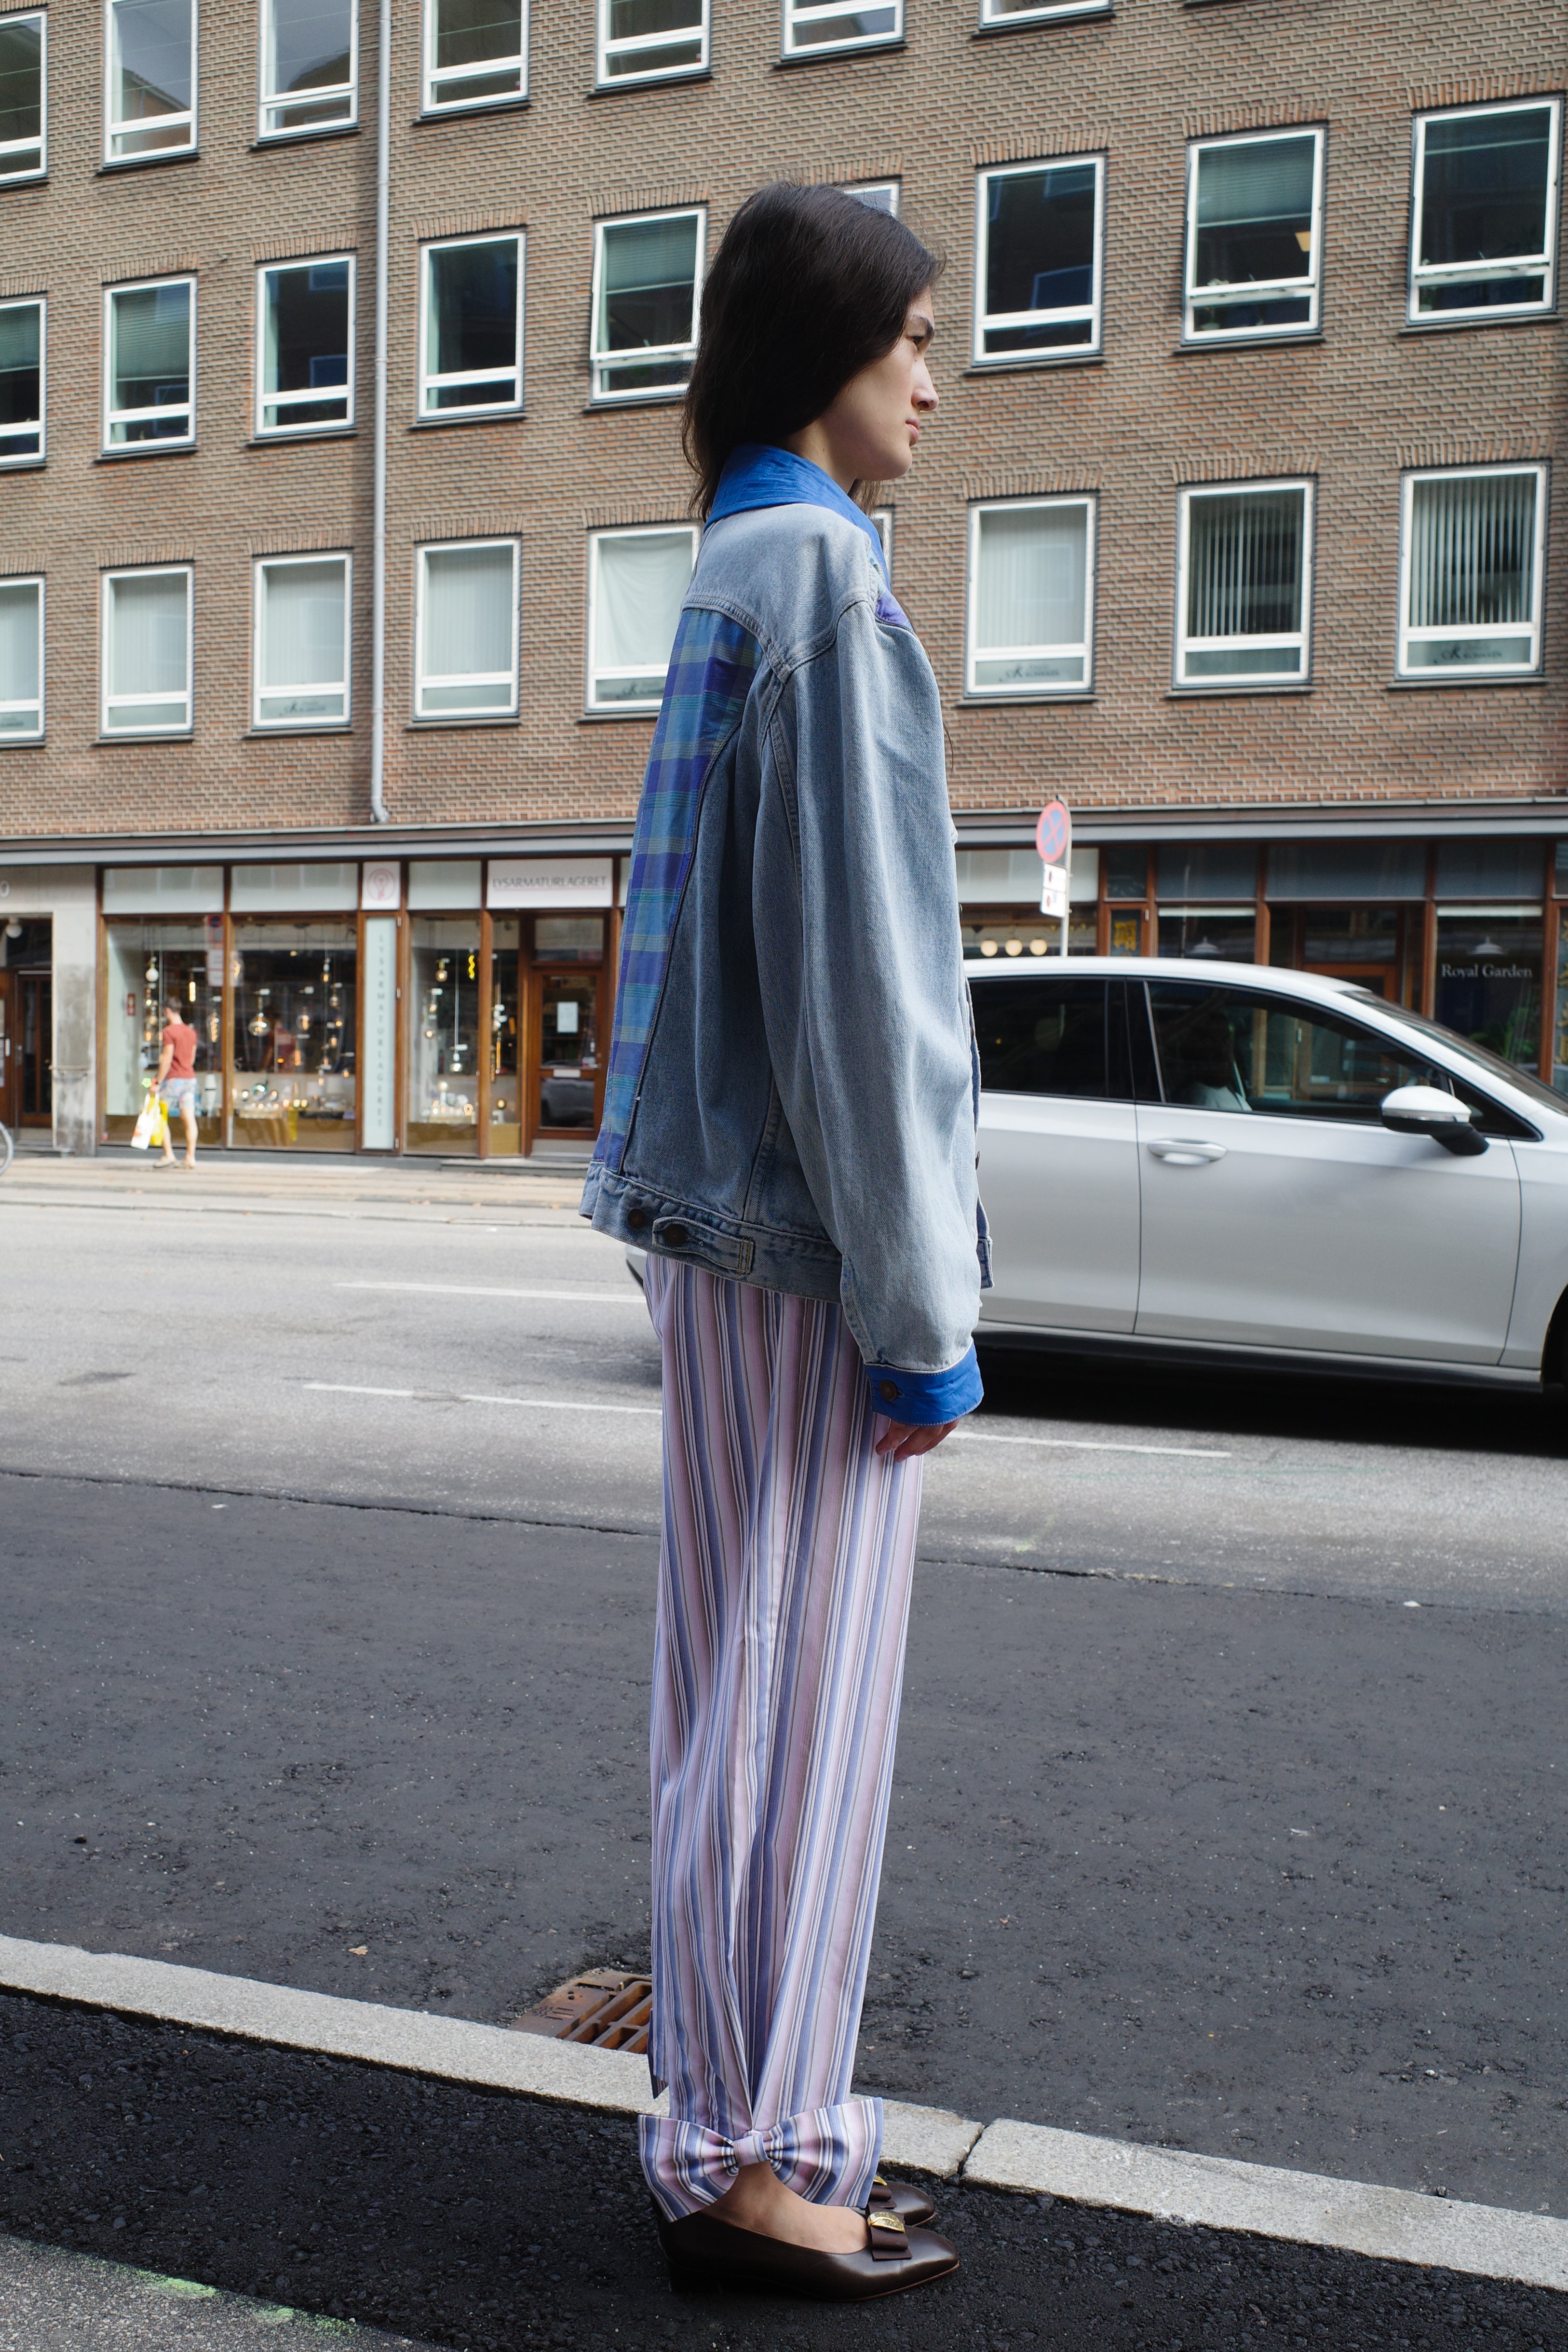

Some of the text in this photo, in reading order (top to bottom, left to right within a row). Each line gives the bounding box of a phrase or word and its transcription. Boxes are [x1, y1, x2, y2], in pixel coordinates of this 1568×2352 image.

[492, 876, 607, 888] LYSARMATURLAGERET
[1441, 963, 1533, 979] Royal Garden
